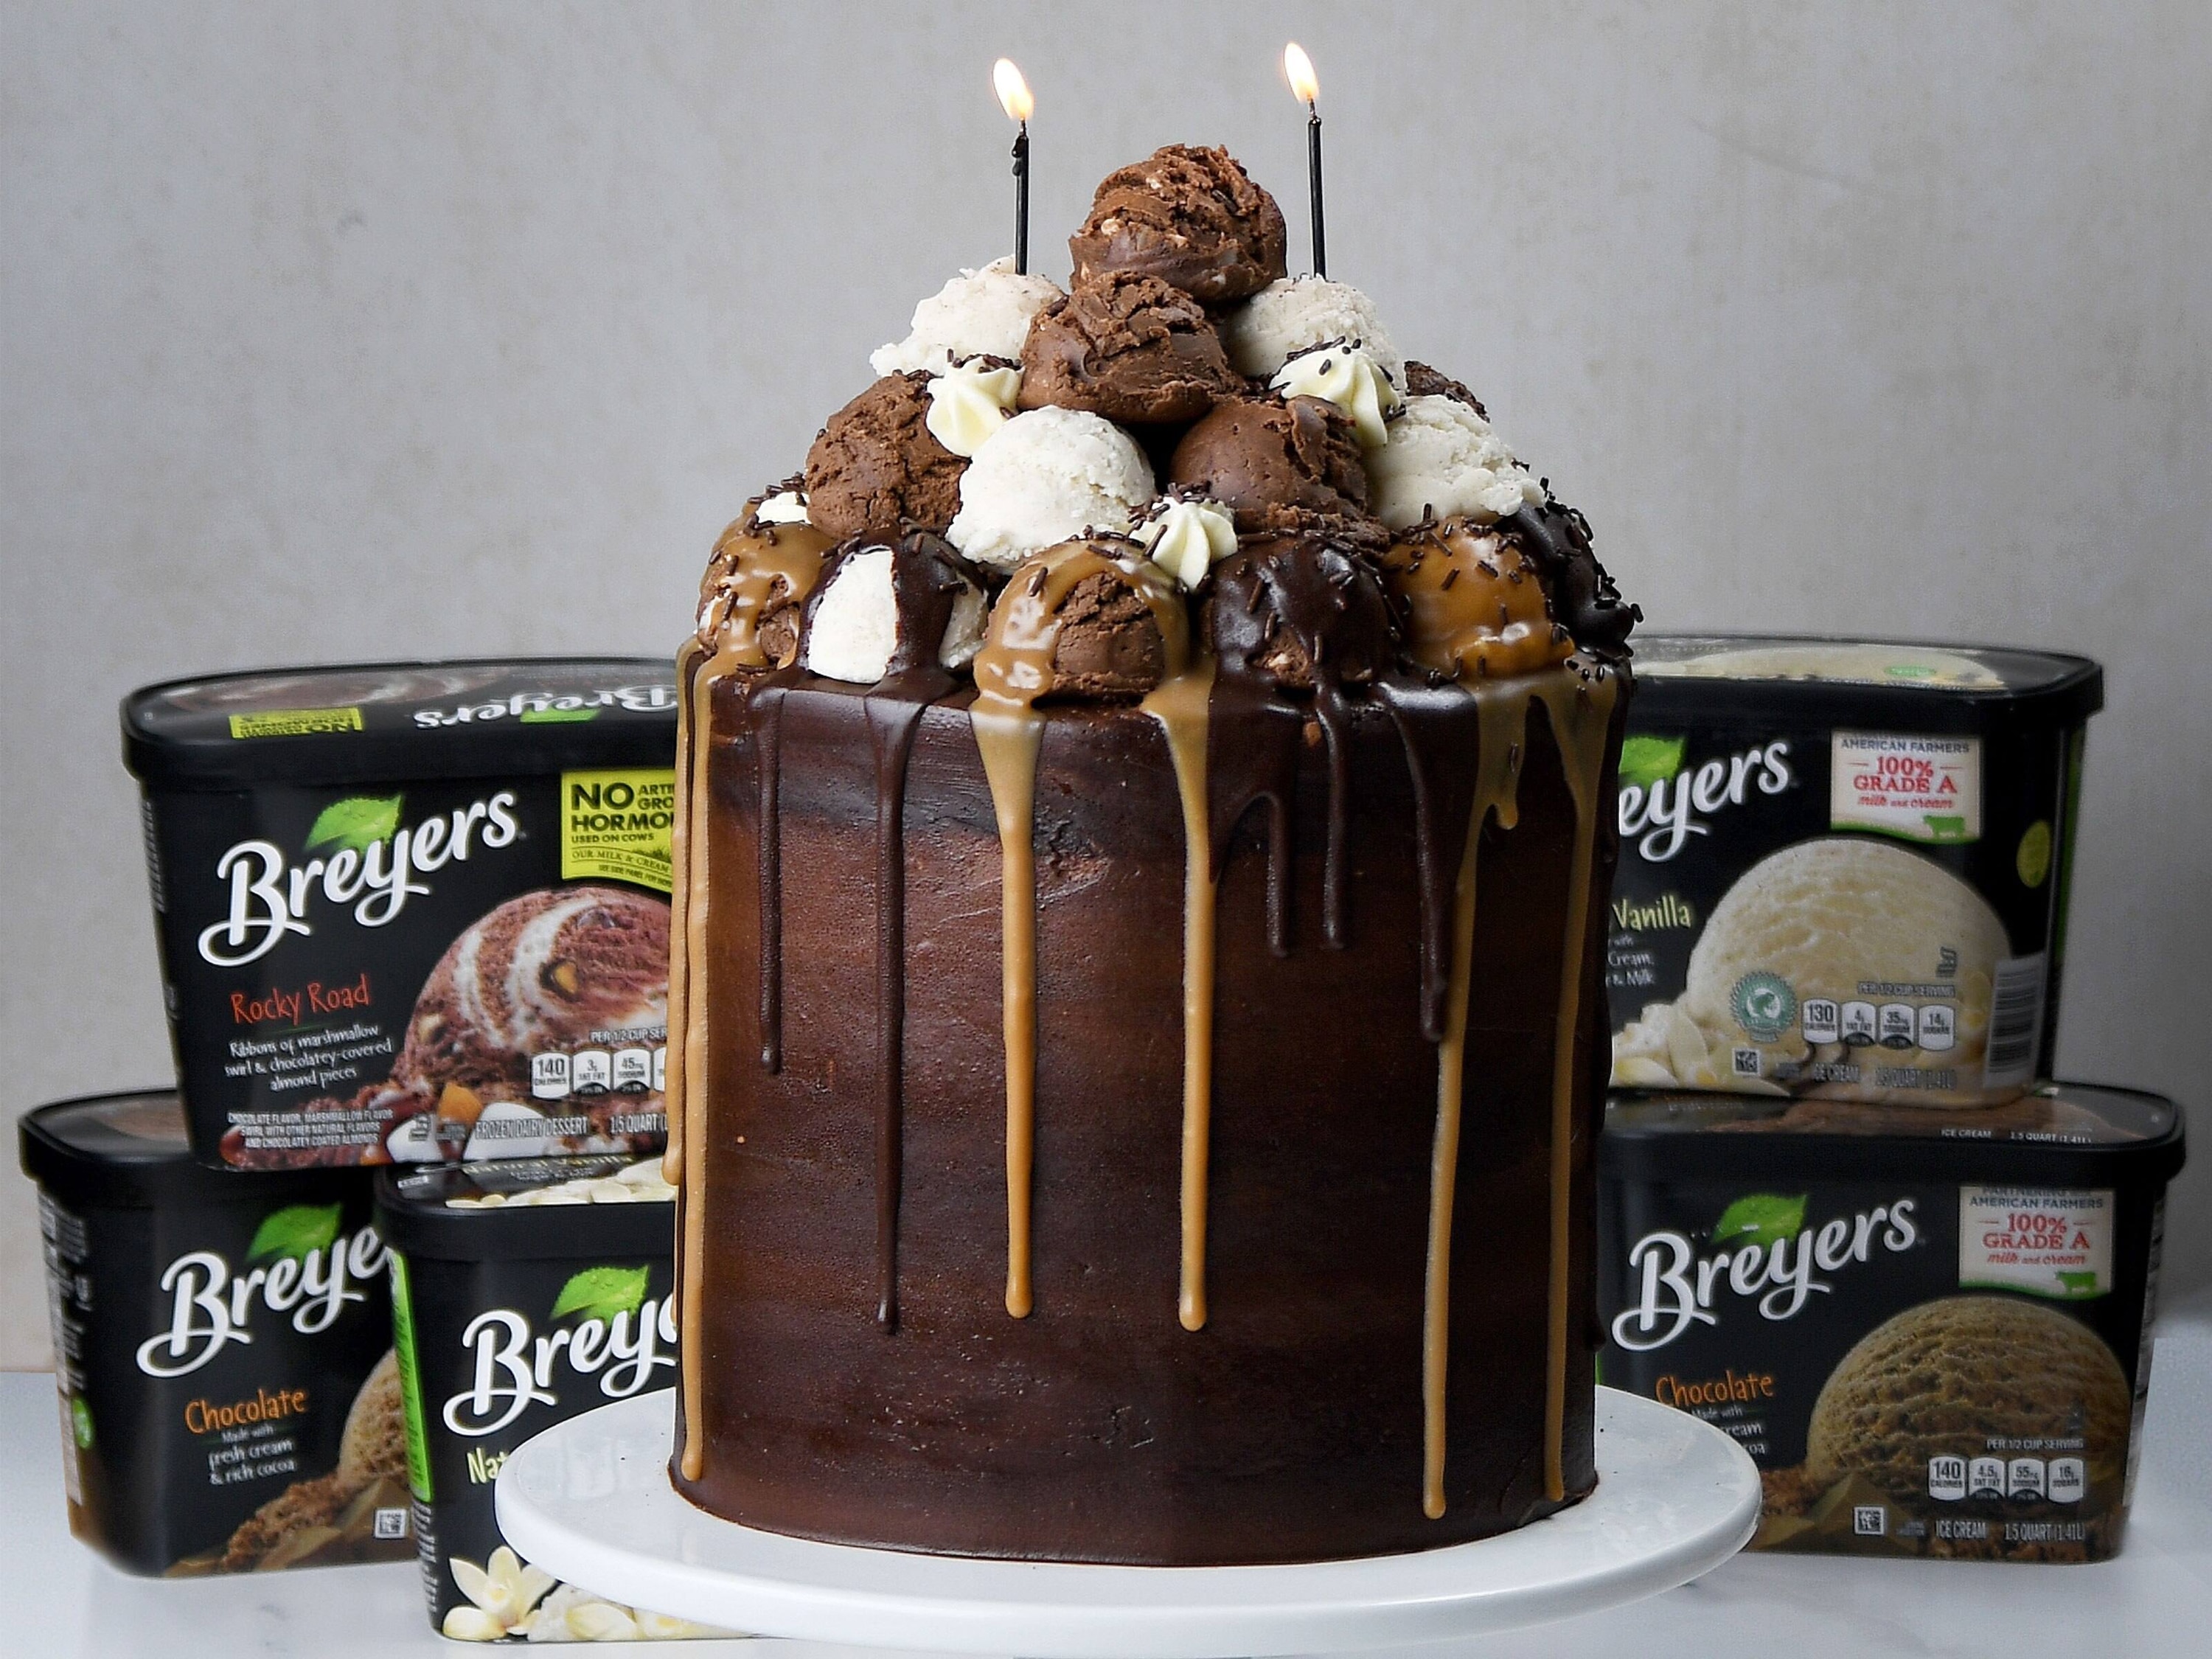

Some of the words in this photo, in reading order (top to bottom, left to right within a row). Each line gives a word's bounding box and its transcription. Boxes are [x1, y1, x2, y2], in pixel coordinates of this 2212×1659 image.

[1842, 739, 1906, 751] AMERICAN
[1910, 742, 1969, 753] FARMERS
[1877, 757, 1934, 777] 100%
[1854, 775, 1930, 793] GRADE
[1936, 776, 1958, 793] A
[571, 782, 635, 810] NO
[638, 796, 674, 810] GRO
[1618, 742, 1789, 862] eyers
[571, 835, 600, 844] USED
[602, 834, 620, 843] ON
[622, 833, 655, 842] COWS
[572, 850, 594, 859] OUR
[597, 851, 622, 860] MILK
[636, 856, 669, 872] CREAM
[198, 791, 518, 967] Breyers
[1612, 895, 1691, 931] Vanilla
[230, 987, 301, 1026] Rocky
[307, 973, 370, 1013] Road
[1809, 1004, 1834, 1022] 130
[230, 1040, 277, 1058] Ribbons
[279, 1039, 295, 1055] of
[298, 1023, 380, 1048] marshmallow
[591, 1030, 611, 1043] PER
[629, 1028, 648, 1040] CUP
[225, 1060, 252, 1077] swirl
[255, 1062, 267, 1074] &
[270, 1037, 392, 1073] chocolatey-covered
[537, 1058, 565, 1077] 140
[270, 1070, 317, 1092] almond
[319, 1066, 357, 1089] pieces
[476, 1119, 515, 1140] FROZEN
[516, 1117, 544, 1138] DAIRY
[545, 1116, 588, 1136] DESSERT
[627, 1113, 658, 1133] QUART
[1941, 1128, 1955, 1137] ICE
[1958, 1129, 1992, 1138] CREAM
[2026, 1133, 2056, 1142] QUART
[1970, 1196, 2038, 1208] AMERICAN
[2043, 1198, 2104, 1209] FARMERS
[2007, 1214, 2067, 1234] 100%
[1983, 1232, 2062, 1250] GRADE
[2070, 1231, 2090, 1250] A
[1987, 1253, 2018, 1265] milk
[2043, 1255, 2086, 1265] cream
[1612, 1199, 1916, 1351] Breyers
[1655, 1370, 1774, 1407] Chocolate
[186, 1389, 306, 1434] Chocolate
[222, 1429, 250, 1444] Made
[252, 1423, 274, 1439] with
[1986, 1439, 2006, 1450] PER
[2023, 1439, 2043, 1450] CUP
[208, 1446, 246, 1472] fresh
[249, 1439, 293, 1458] cream
[209, 1471, 223, 1485] &
[226, 1465, 254, 1484] rich
[257, 1458, 295, 1478] cocoa
[1934, 1461, 1961, 1479] 140
[1935, 1520, 1952, 1538] ICE
[1953, 1520, 1986, 1539] CREAM
[2005, 1523, 2019, 1540] 1.5
[2020, 1522, 2051, 1540] QUART
